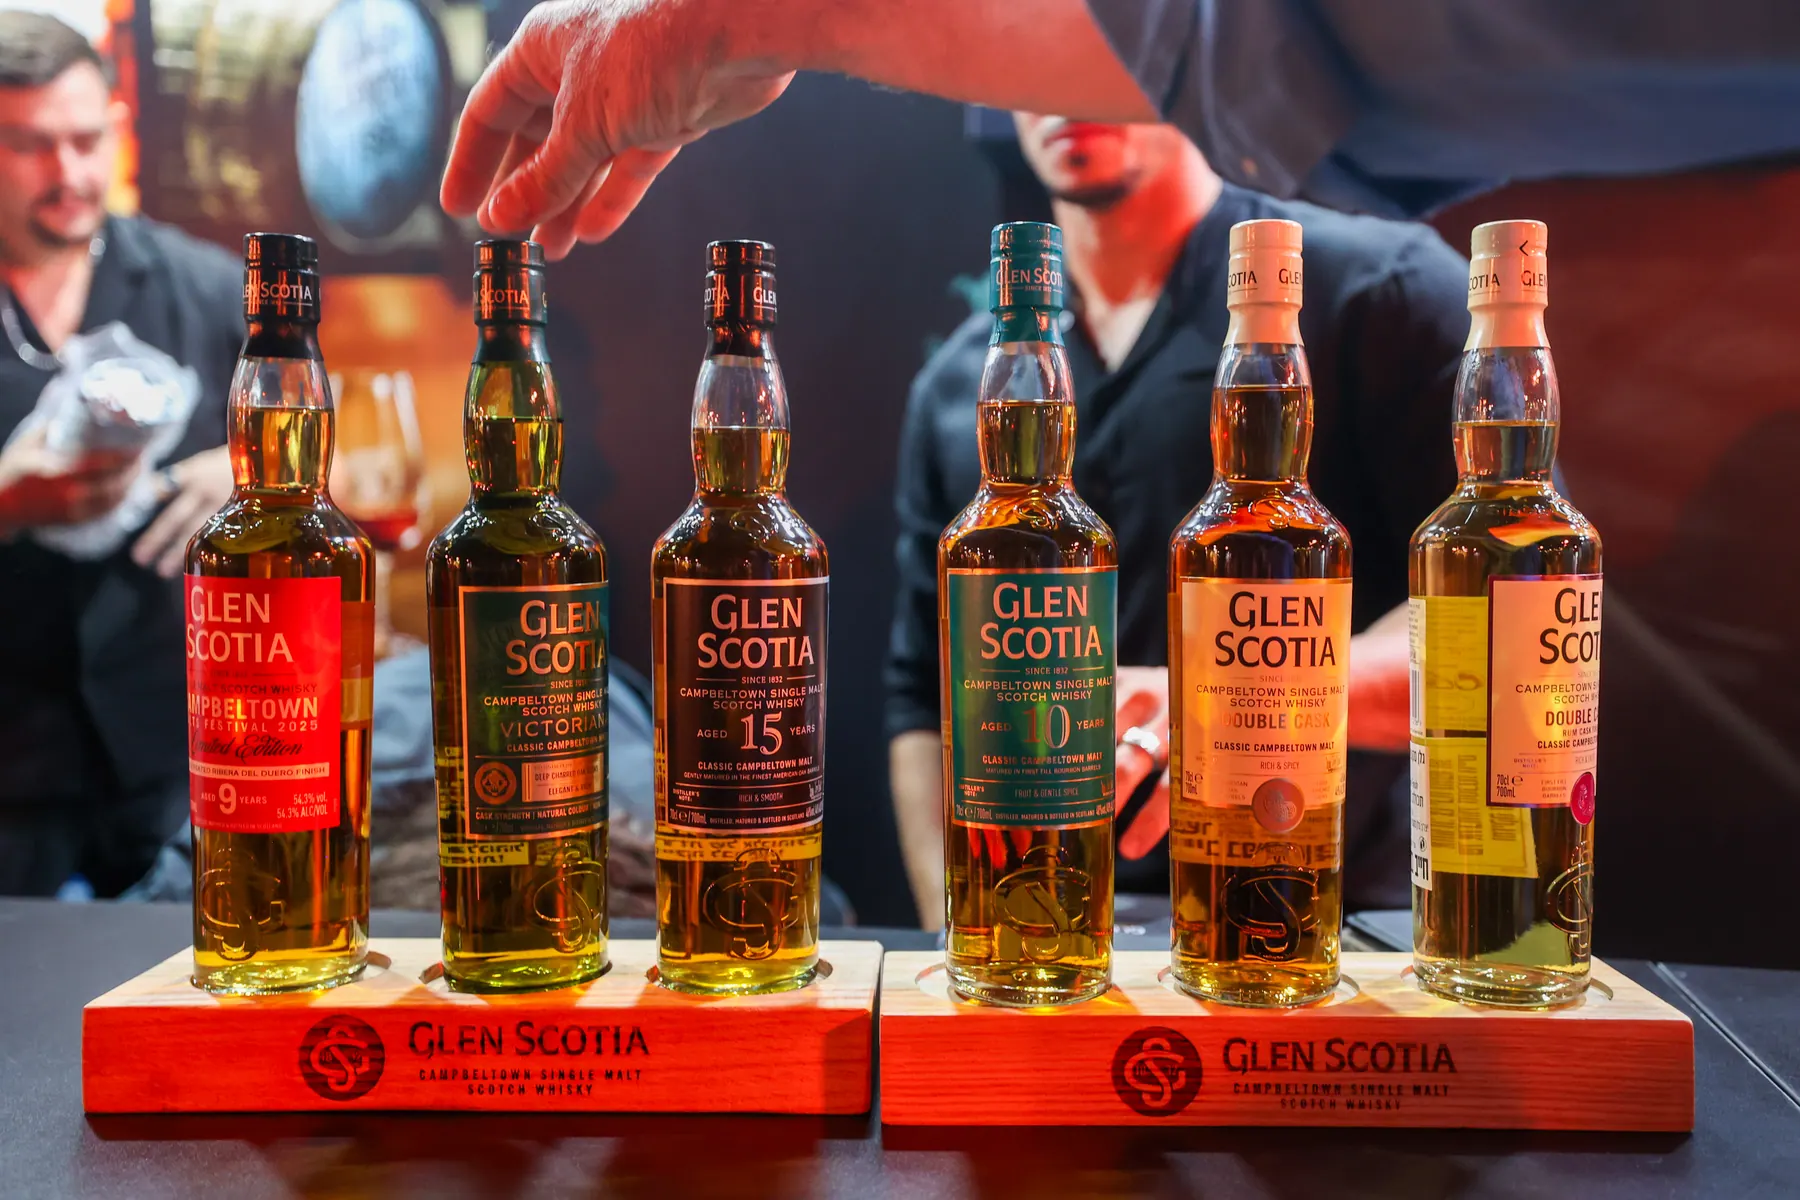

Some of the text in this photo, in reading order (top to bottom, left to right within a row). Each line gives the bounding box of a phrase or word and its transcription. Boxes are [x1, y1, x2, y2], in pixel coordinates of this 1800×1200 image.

[996, 269, 1031, 285] GLEN
[261, 281, 312, 300] SCOTIA
[190, 585, 270, 624] GLEN
[993, 582, 1089, 623] GLEN
[1554, 587, 1602, 628] GLE
[711, 593, 803, 634] GLEN
[1229, 591, 1324, 631] GLEN
[520, 600, 600, 640] GLEN
[187, 624, 294, 663] SCOTIA
[980, 622, 1103, 660] SCOTIA
[697, 632, 815, 669] SCOTIA
[1215, 630, 1336, 668] SCOTIA
[505, 639, 607, 676] SCOTIA
[1025, 667, 1051, 675] SINCE
[550, 679, 573, 689] SINCE
[741, 676, 767, 685] SINCE
[963, 675, 1113, 691] CAMPBELTOWN SINGLE MALT
[221, 683, 317, 695] SCOTCH WHISKY
[679, 683, 824, 699] CAMPBELTOWN SINGLE MALT
[1196, 684, 1345, 697] CAMPBELTOWN SINGLE MALT
[1515, 682, 1592, 693] CAMPBELTOWN
[483, 688, 603, 706] CAMPBELTOWN SINGLE
[996, 690, 1092, 701] SCOTCH WHISKY
[1554, 694, 1590, 704] SCOTCH
[188, 692, 318, 720] AMPBELTOWN
[522, 700, 602, 716] SCOTCH WHISKY
[713, 698, 805, 710] SCOTCH WHISKY
[1230, 698, 1326, 708] SCOTCH WHISKY
[1222, 712, 1330, 729] DOUBLE CASK
[1545, 708, 1592, 727] DOUBLE
[204, 718, 318, 732] FESTIVAL 2025
[980, 704, 1105, 749] AGED 10 YEARS
[696, 711, 816, 756] AGED 15 YEARS
[1562, 728, 1577, 737] RUM
[1579, 727, 1591, 735] CASK
[235, 734, 303, 765] Edition
[506, 742, 544, 752] CLASSIC
[1214, 741, 1335, 752] CLASSIC CAMPBELTOWN MALT
[1537, 740, 1571, 749] CLASSIC
[698, 755, 813, 771] CLASSIC CAMPBELTOWN MALT
[982, 752, 1103, 765] CLASSIC CAMPBELTOWN MALT
[211, 767, 326, 777] RIBERA DEL DUERO FINISH
[1260, 761, 1300, 770] RICH & SPICY
[534, 773, 550, 781] DEEP
[683, 771, 703, 779] GENTLY
[1496, 774, 1510, 786] 70cl
[760, 792, 784, 801] SMOOTH
[1015, 788, 1032, 798] FRUIT
[1040, 788, 1062, 798] GENTLE
[1063, 787, 1079, 796] SPICE
[1496, 786, 1516, 798] 700mL
[218, 783, 237, 815] 9
[239, 796, 268, 804] YEARS
[293, 793, 315, 805] 54.3%
[276, 806, 299, 819] 54.3%
[300, 804, 328, 818] ALC/VOL
[475, 811, 493, 820] CASK
[537, 808, 567, 819] NATURAL
[1049, 812, 1069, 820] BOTTLED
[762, 815, 781, 823] BOTTLED
[408, 1020, 650, 1060] GLEN SCOTIA
[1222, 1036, 1458, 1076] GLEN SCOTIA
[419, 1069, 642, 1081] CAMPBELTOWN SINGLE MALT
[467, 1083, 594, 1096] SCOTCH WHISKY
[1233, 1082, 1342, 1095] CAMPBELTOWN
[1351, 1083, 1403, 1096] SINGLE
[1280, 1098, 1402, 1110] SCOTCH WHISKY
